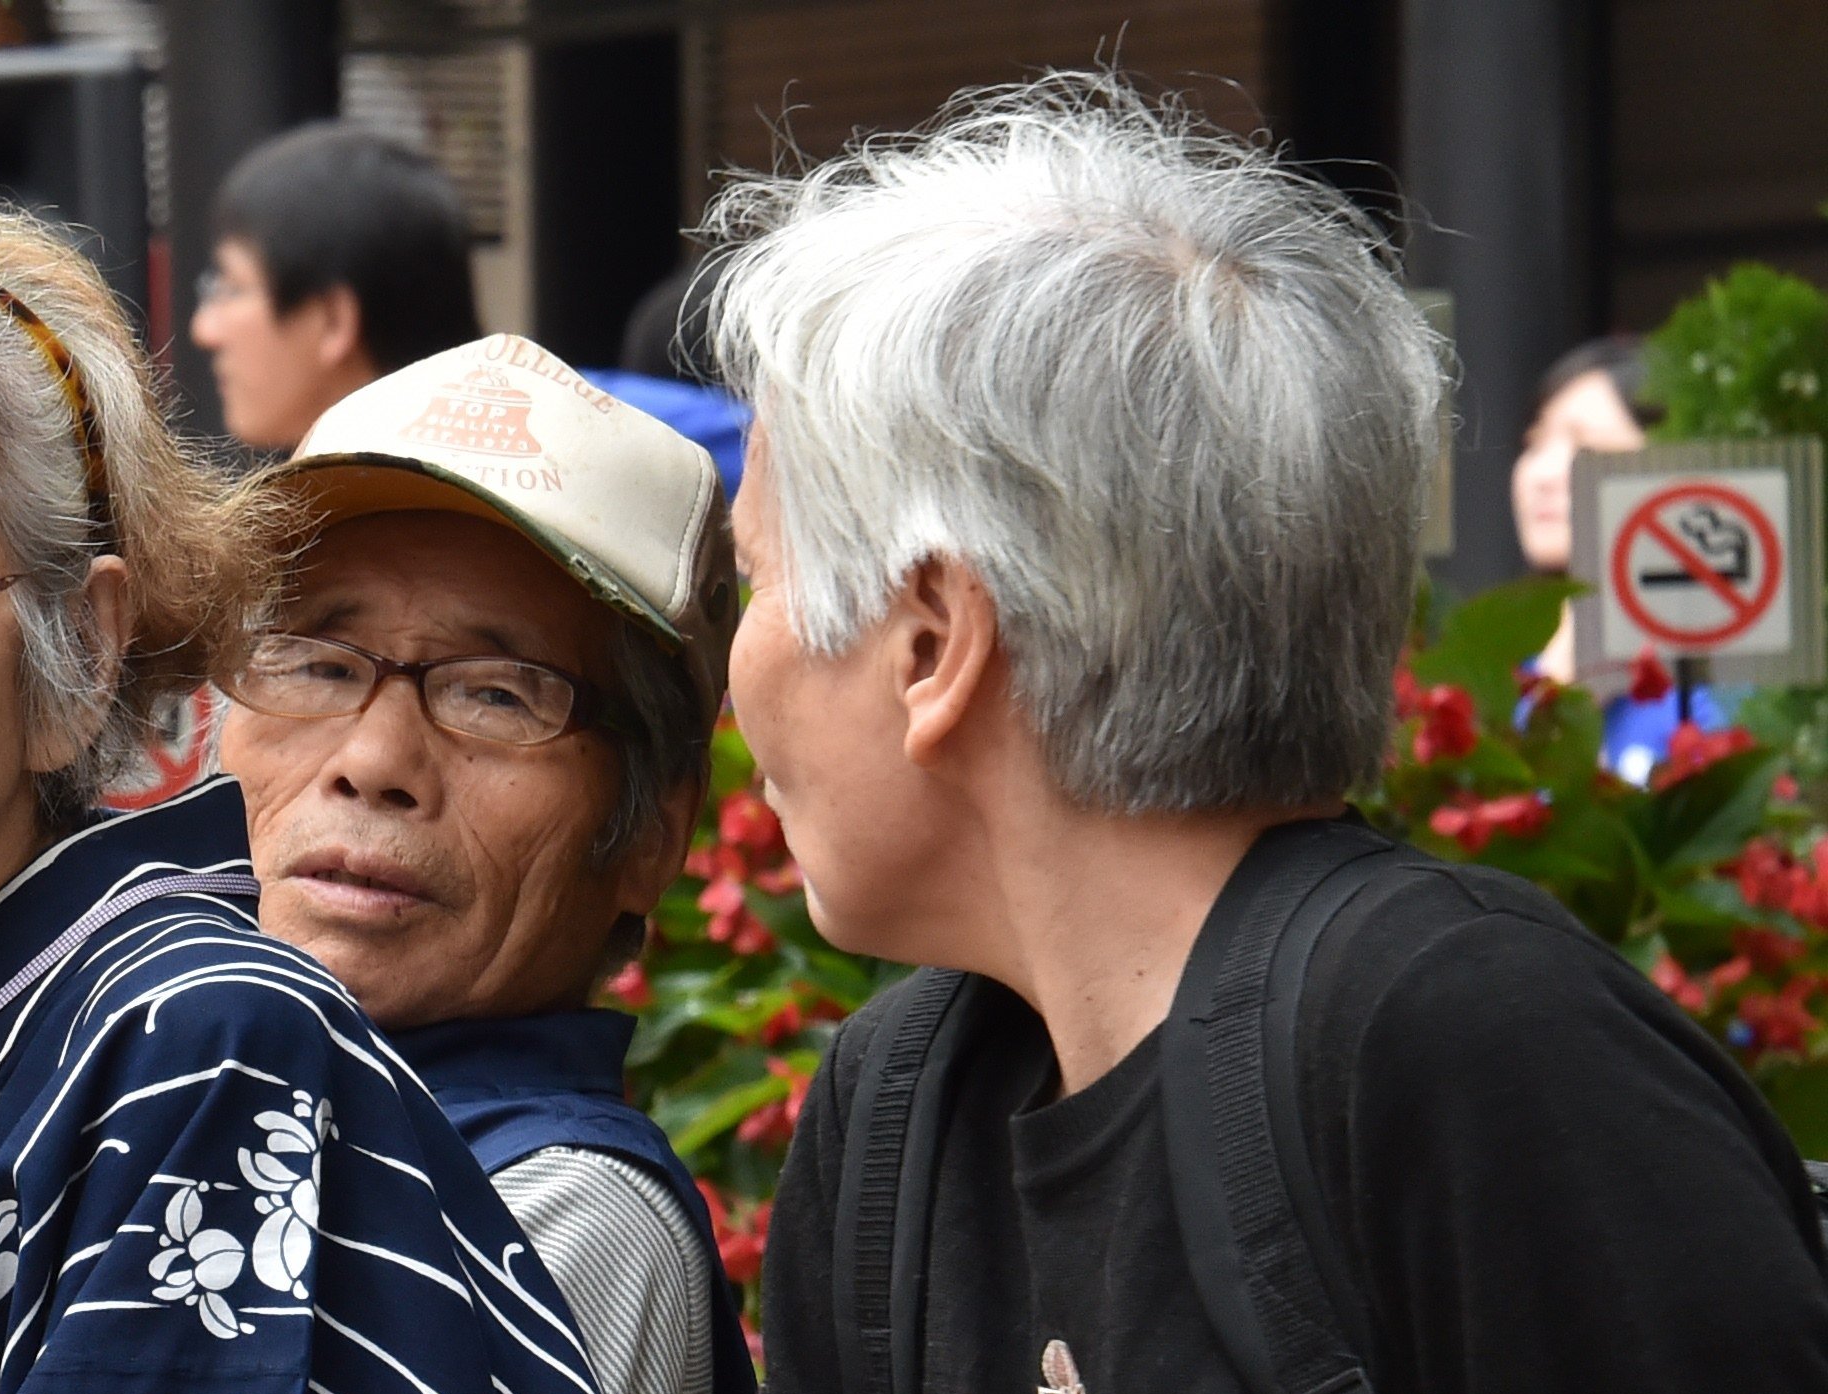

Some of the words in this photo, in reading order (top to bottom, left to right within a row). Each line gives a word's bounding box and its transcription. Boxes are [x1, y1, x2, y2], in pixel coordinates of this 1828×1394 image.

[448, 400, 508, 419] TOP
[426, 413, 517, 437] QUALITY
[469, 465, 563, 492] TION
